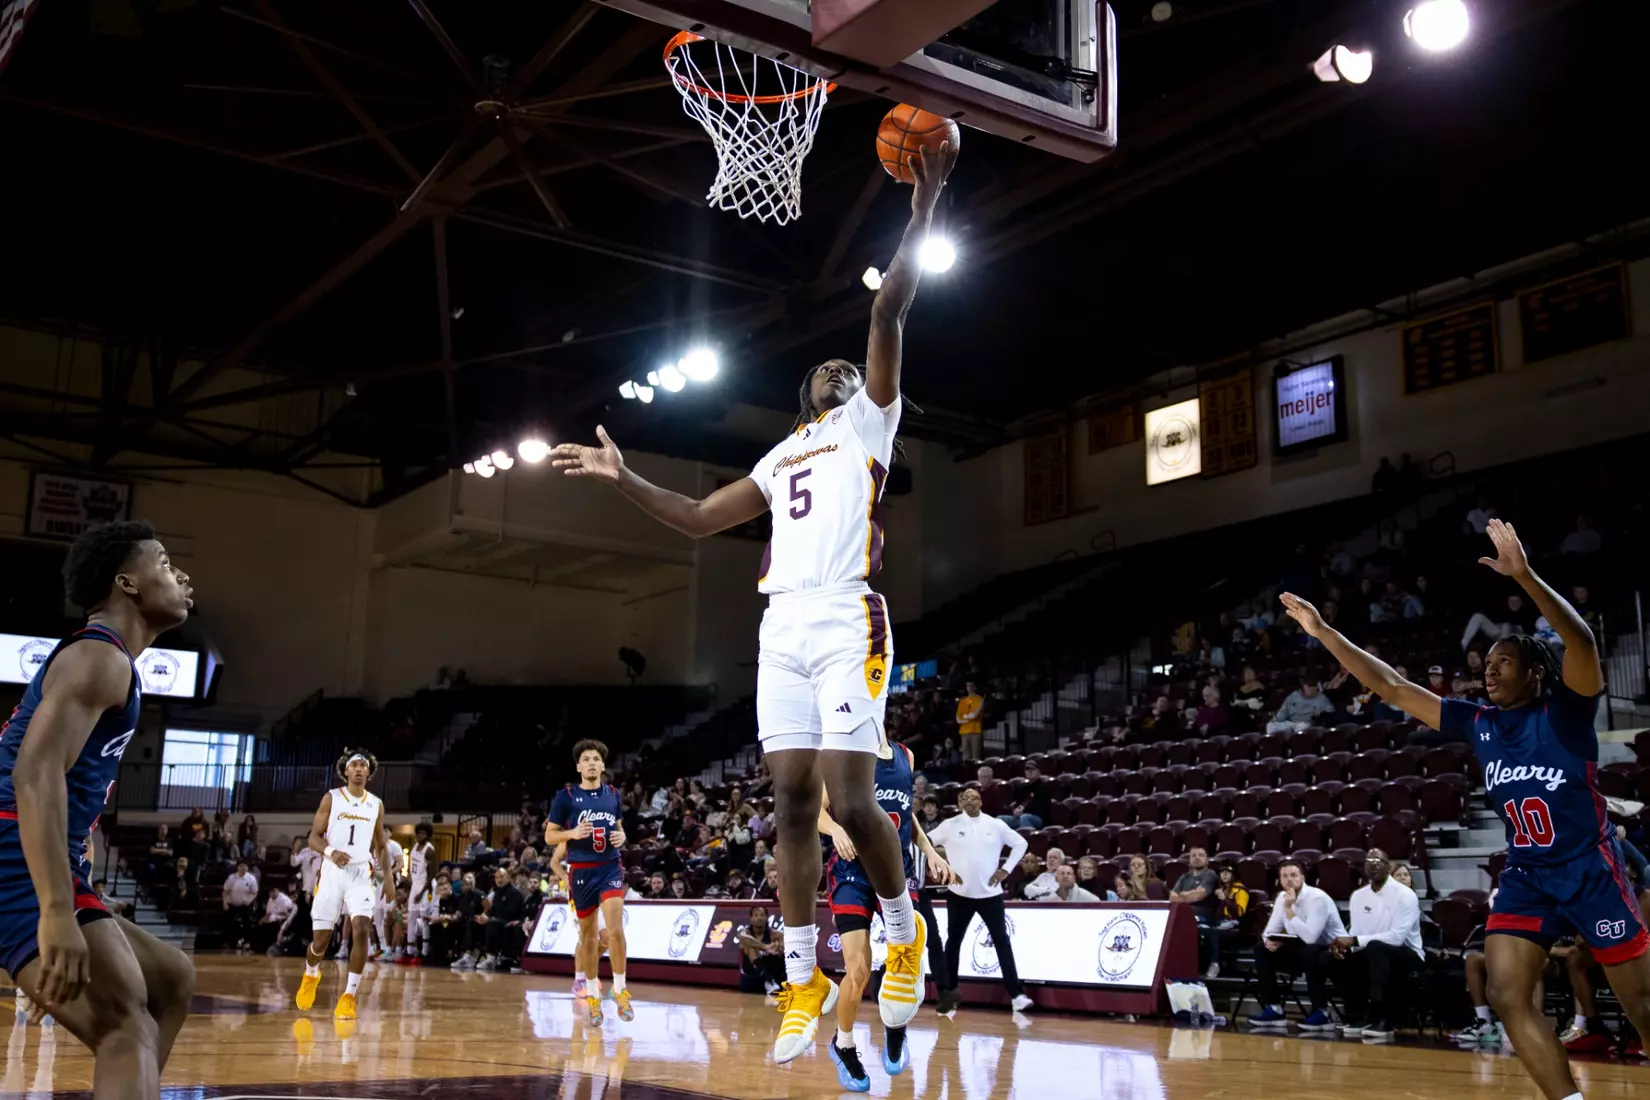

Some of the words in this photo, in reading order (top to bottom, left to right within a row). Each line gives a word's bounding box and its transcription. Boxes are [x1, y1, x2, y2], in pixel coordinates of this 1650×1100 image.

[1279, 390, 1333, 418] meijer
[773, 443, 839, 478] Chippewas
[789, 468, 812, 520] 5
[1485, 759, 1566, 791] Cleary
[874, 782, 911, 811] eary
[577, 808, 616, 827] Cleary
[1504, 796, 1555, 847] 10
[347, 824, 356, 846] 1
[592, 827, 607, 853] 5
[1596, 919, 1626, 939] CU
